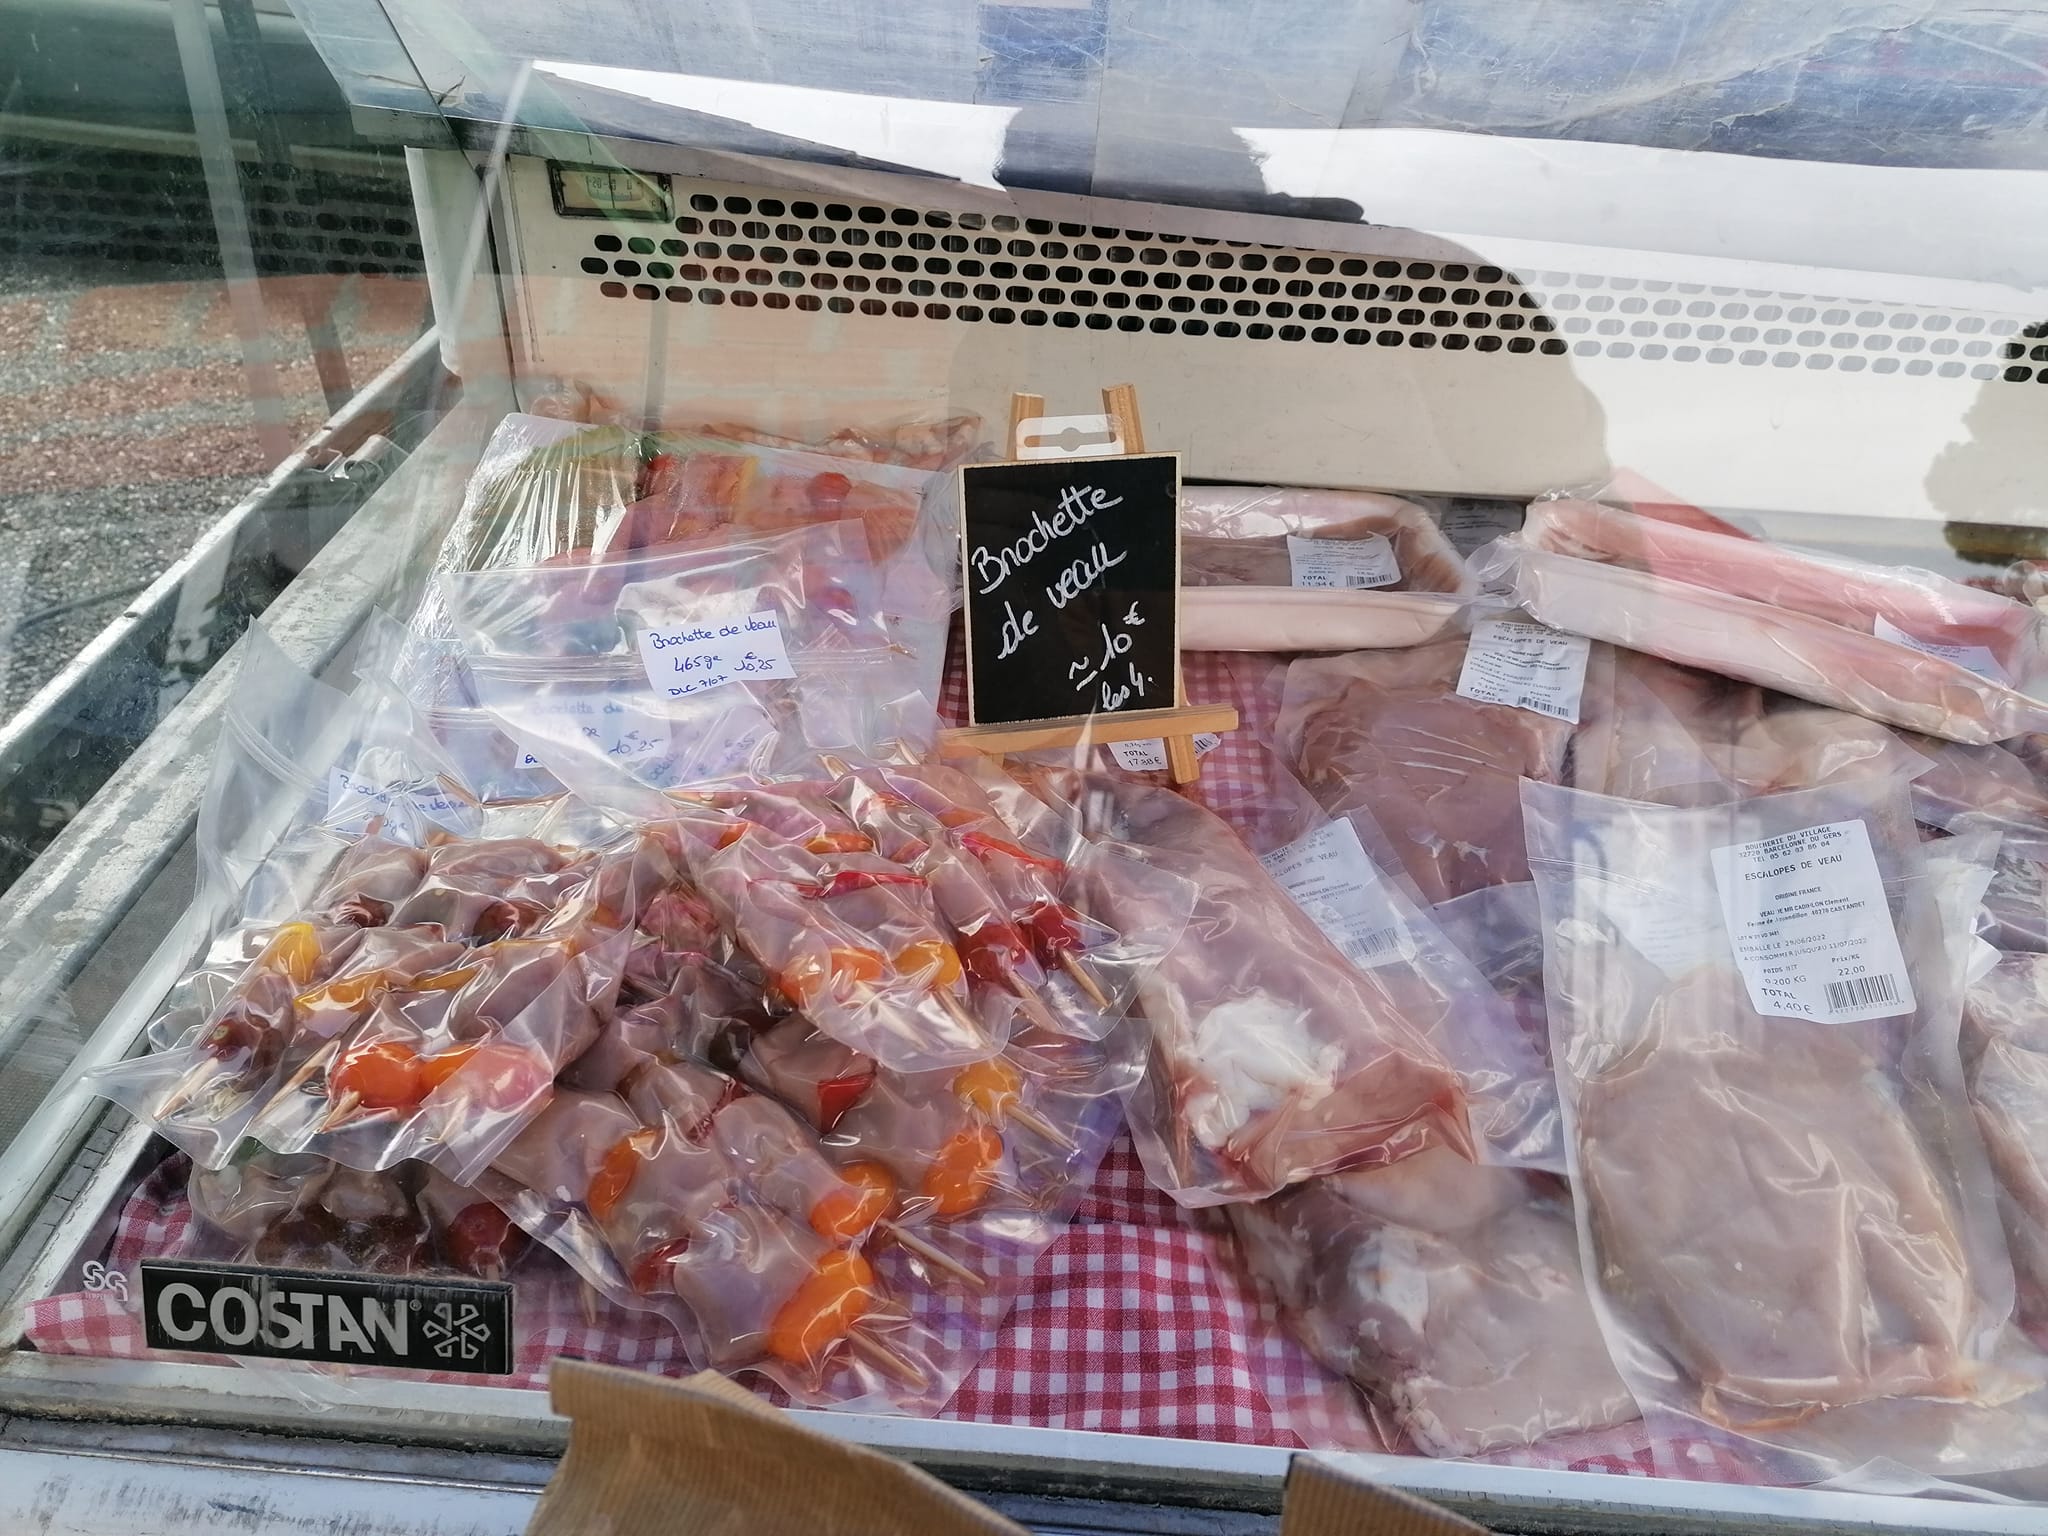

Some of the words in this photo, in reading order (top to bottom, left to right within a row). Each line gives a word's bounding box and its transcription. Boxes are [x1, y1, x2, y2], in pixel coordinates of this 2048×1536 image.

[971, 485, 1123, 594] Brochette
[997, 601, 1039, 660] de
[1046, 542, 1128, 609] veau
[650, 627, 715, 649] Brochette
[719, 625, 741, 637] de
[668, 685, 698, 696] DLC
[1102, 682, 1130, 711] les
[1470, 687, 1497, 697] TOTAL
[1745, 837, 1783, 850] BOUCHERIE
[1800, 826, 1831, 838] VILLAGE
[1763, 839, 1808, 854] BARCELONNE
[1823, 832, 1842, 840] GERS
[1745, 864, 1796, 881] ESCALOPES
[1800, 861, 1813, 869] DE
[1818, 854, 1842, 866] VEAU
[1831, 953, 1861, 963] Prix/KG
[1793, 975, 1807, 983] KG
[1761, 988, 1797, 1000] TOTAL
[157, 1281, 408, 1356] COSTAN
